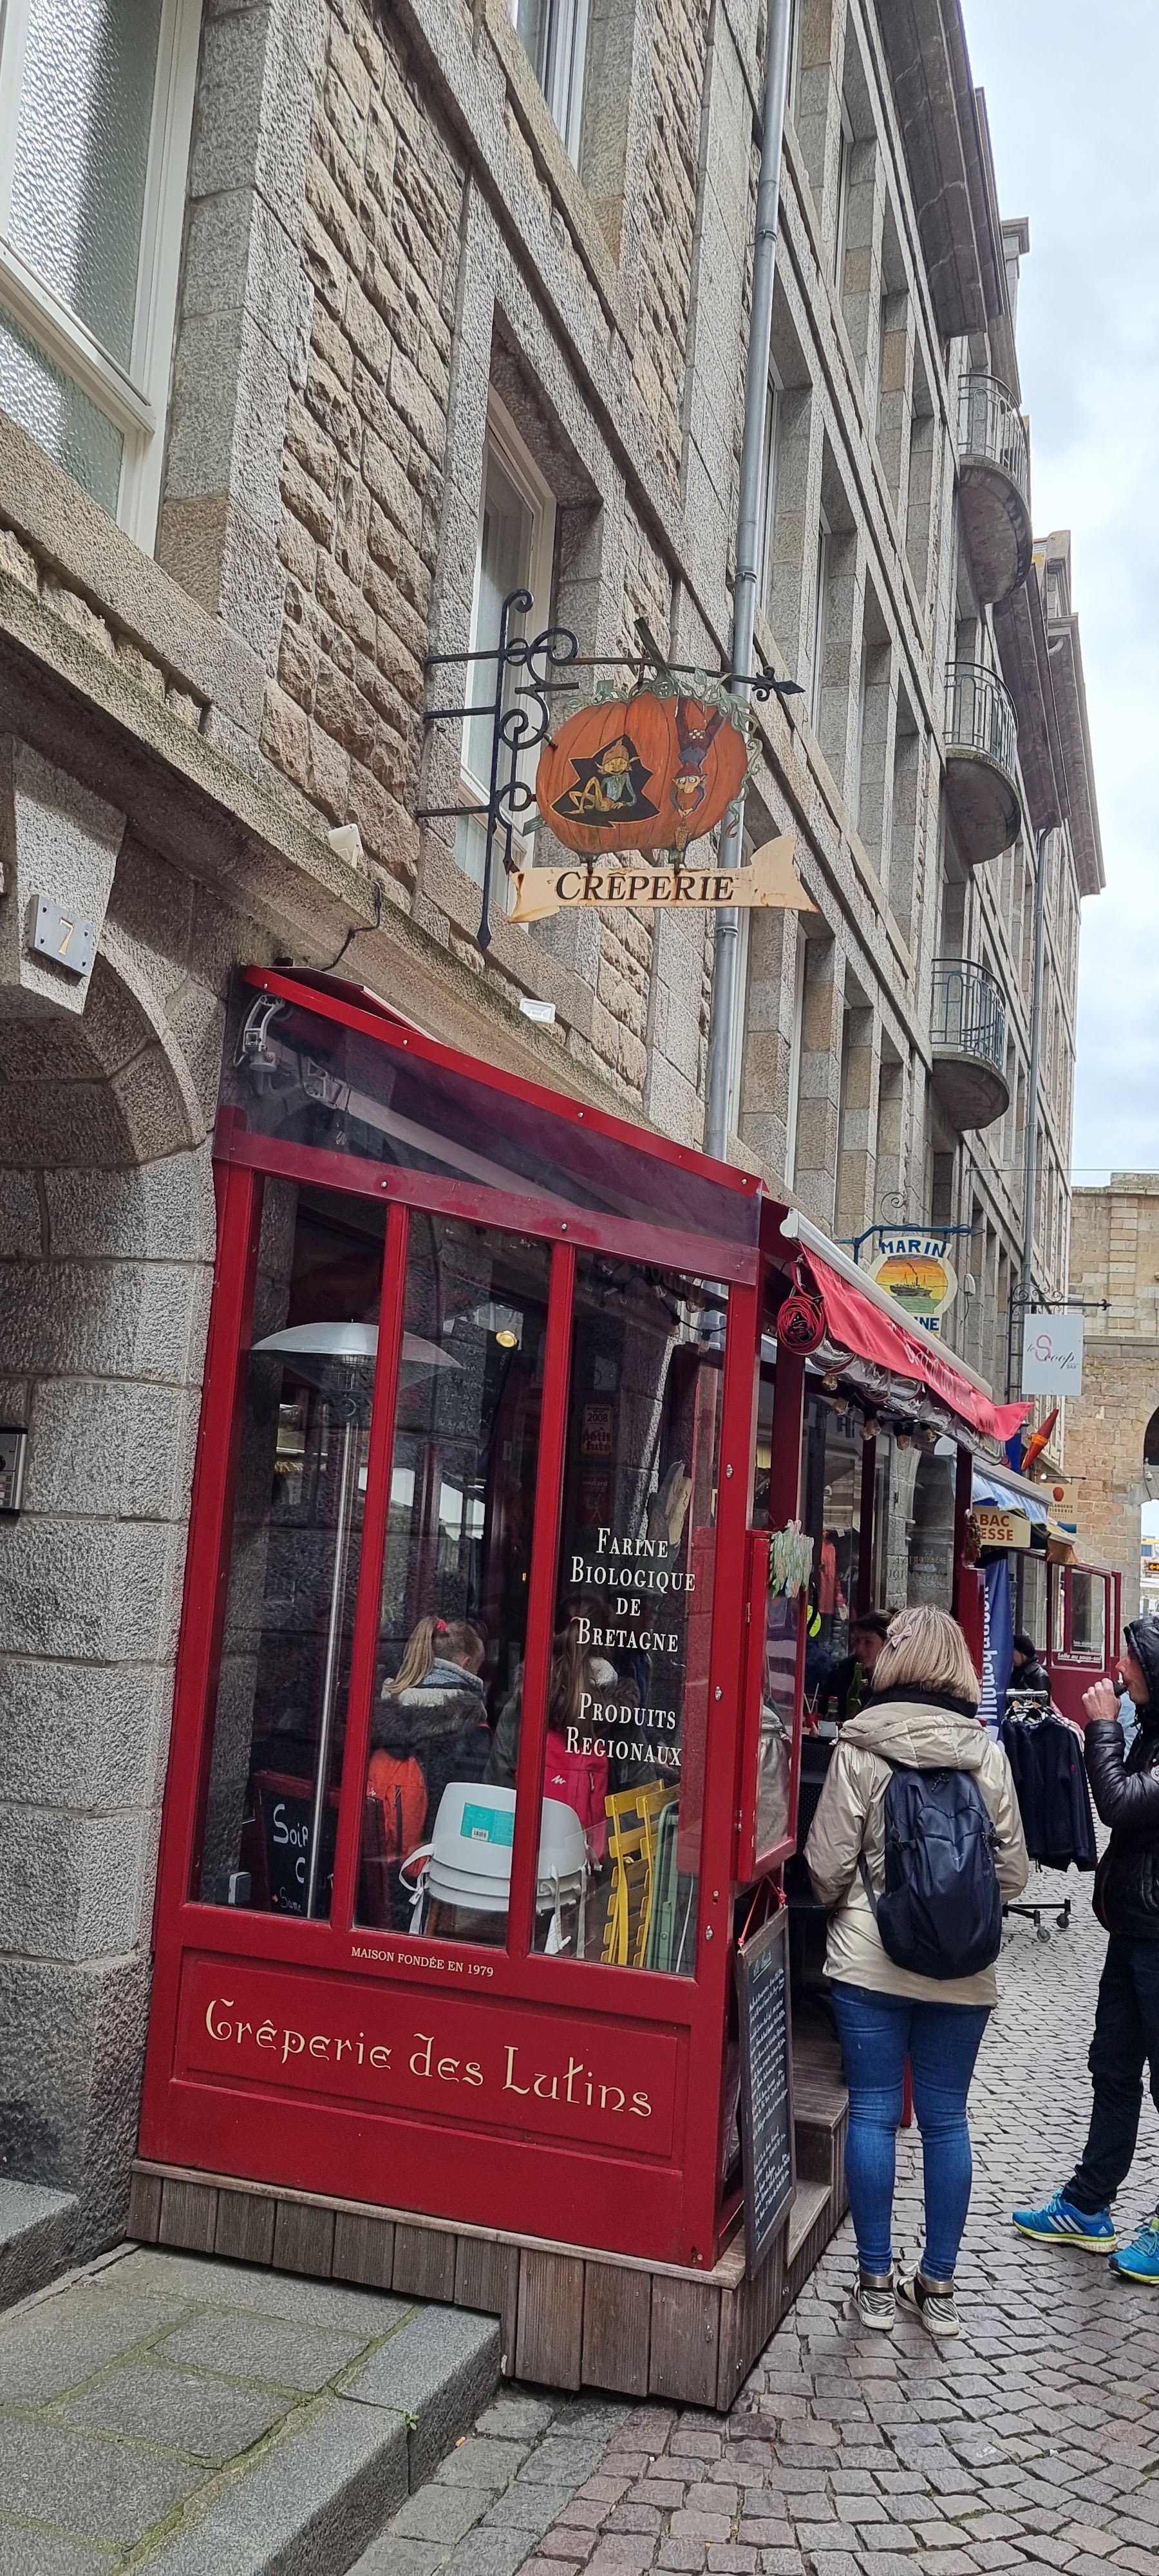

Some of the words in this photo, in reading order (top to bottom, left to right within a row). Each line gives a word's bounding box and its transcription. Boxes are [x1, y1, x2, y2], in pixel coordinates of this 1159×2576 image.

[555, 871, 735, 901] CRÊPERIE
[58, 916, 75, 956] 7
[880, 1239, 947, 1258] MARIN
[1034, 1334, 1075, 1369] Scoop
[587, 1413, 608, 1423] 2008
[981, 1528, 1013, 1541] ESSE
[616, 1597, 641, 1616] DE
[351, 1947, 395, 1962] MAISON
[397, 1953, 444, 1969] FONDÉE
[448, 1961, 464, 1972] EN
[467, 1964, 494, 1977] 1979
[205, 1998, 391, 2070] Crêperie
[410, 2033, 484, 2087] des
[502, 2046, 652, 2117] Lutins
